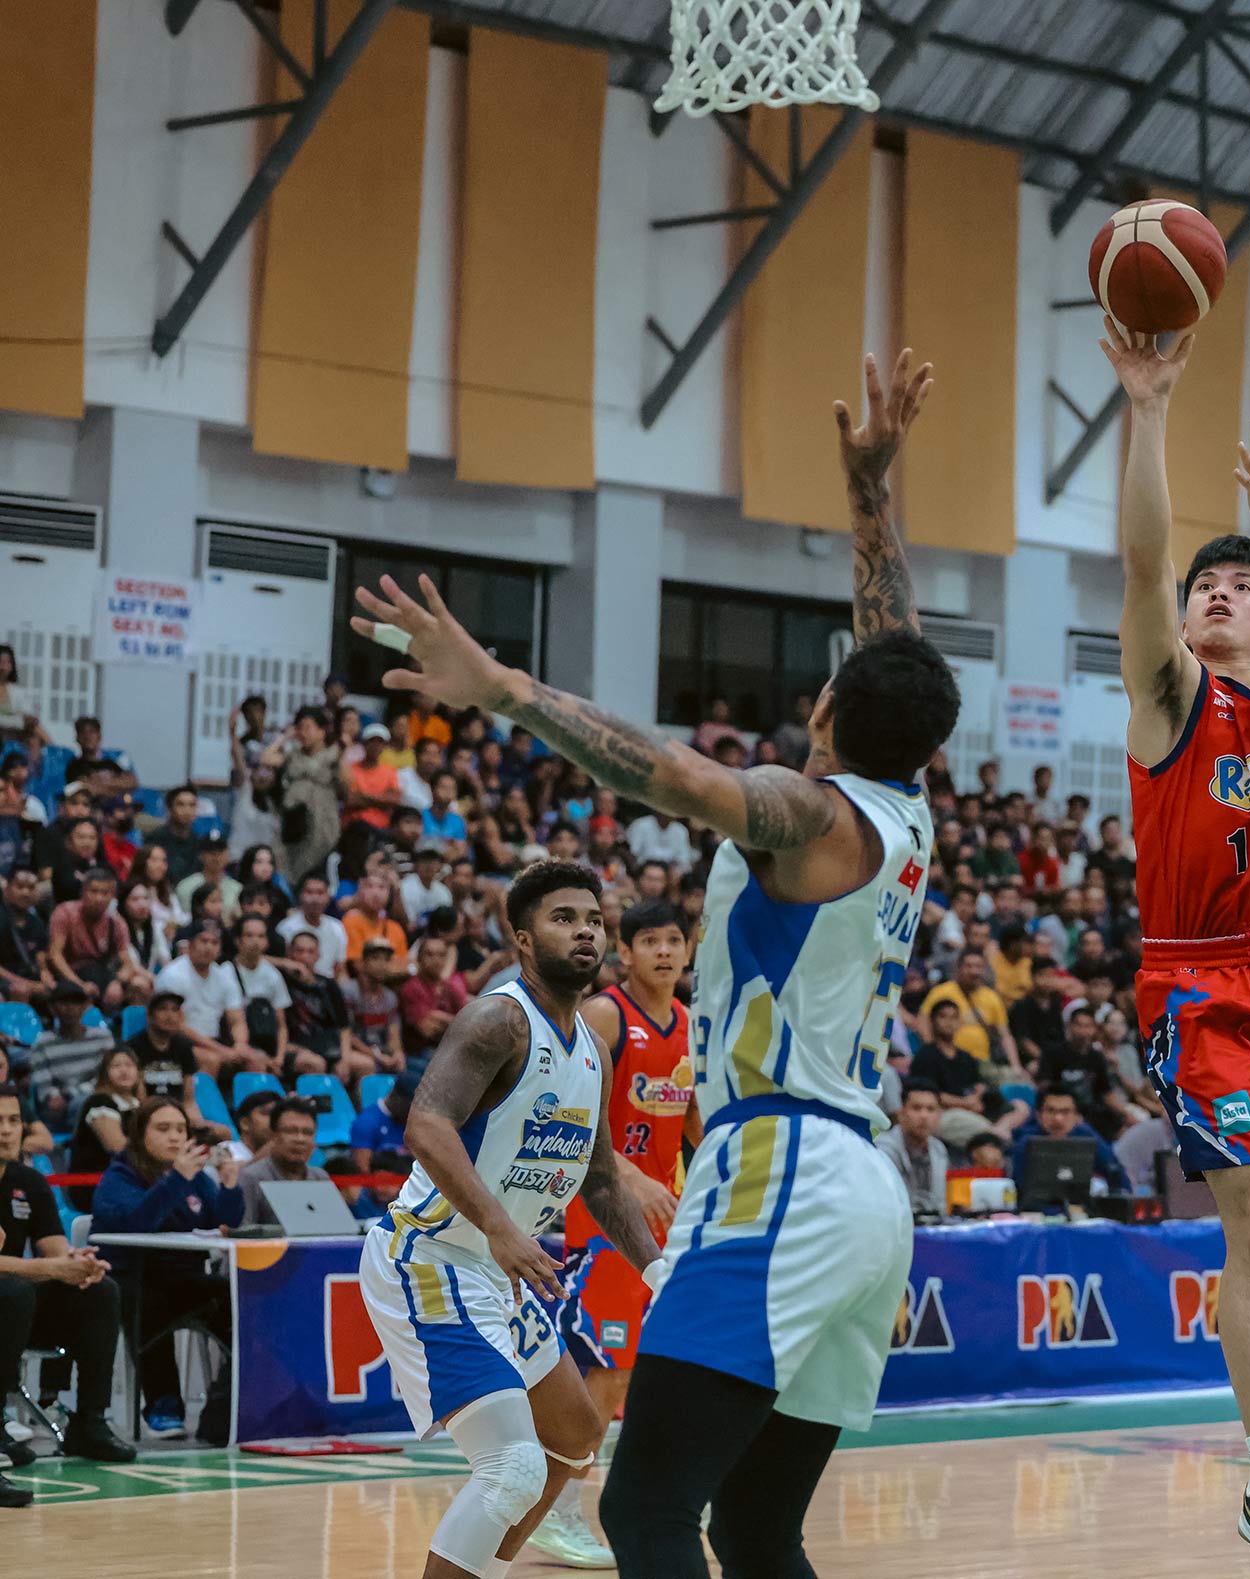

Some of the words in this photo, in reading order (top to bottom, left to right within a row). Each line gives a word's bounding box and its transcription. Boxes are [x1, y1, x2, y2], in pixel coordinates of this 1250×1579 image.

[1227, 827, 1249, 875] 1
[1222, 1105, 1247, 1120] Sista
[623, 1122, 651, 1155] 22
[508, 1300, 552, 1361] 23
[1016, 1273, 1119, 1351] PBA
